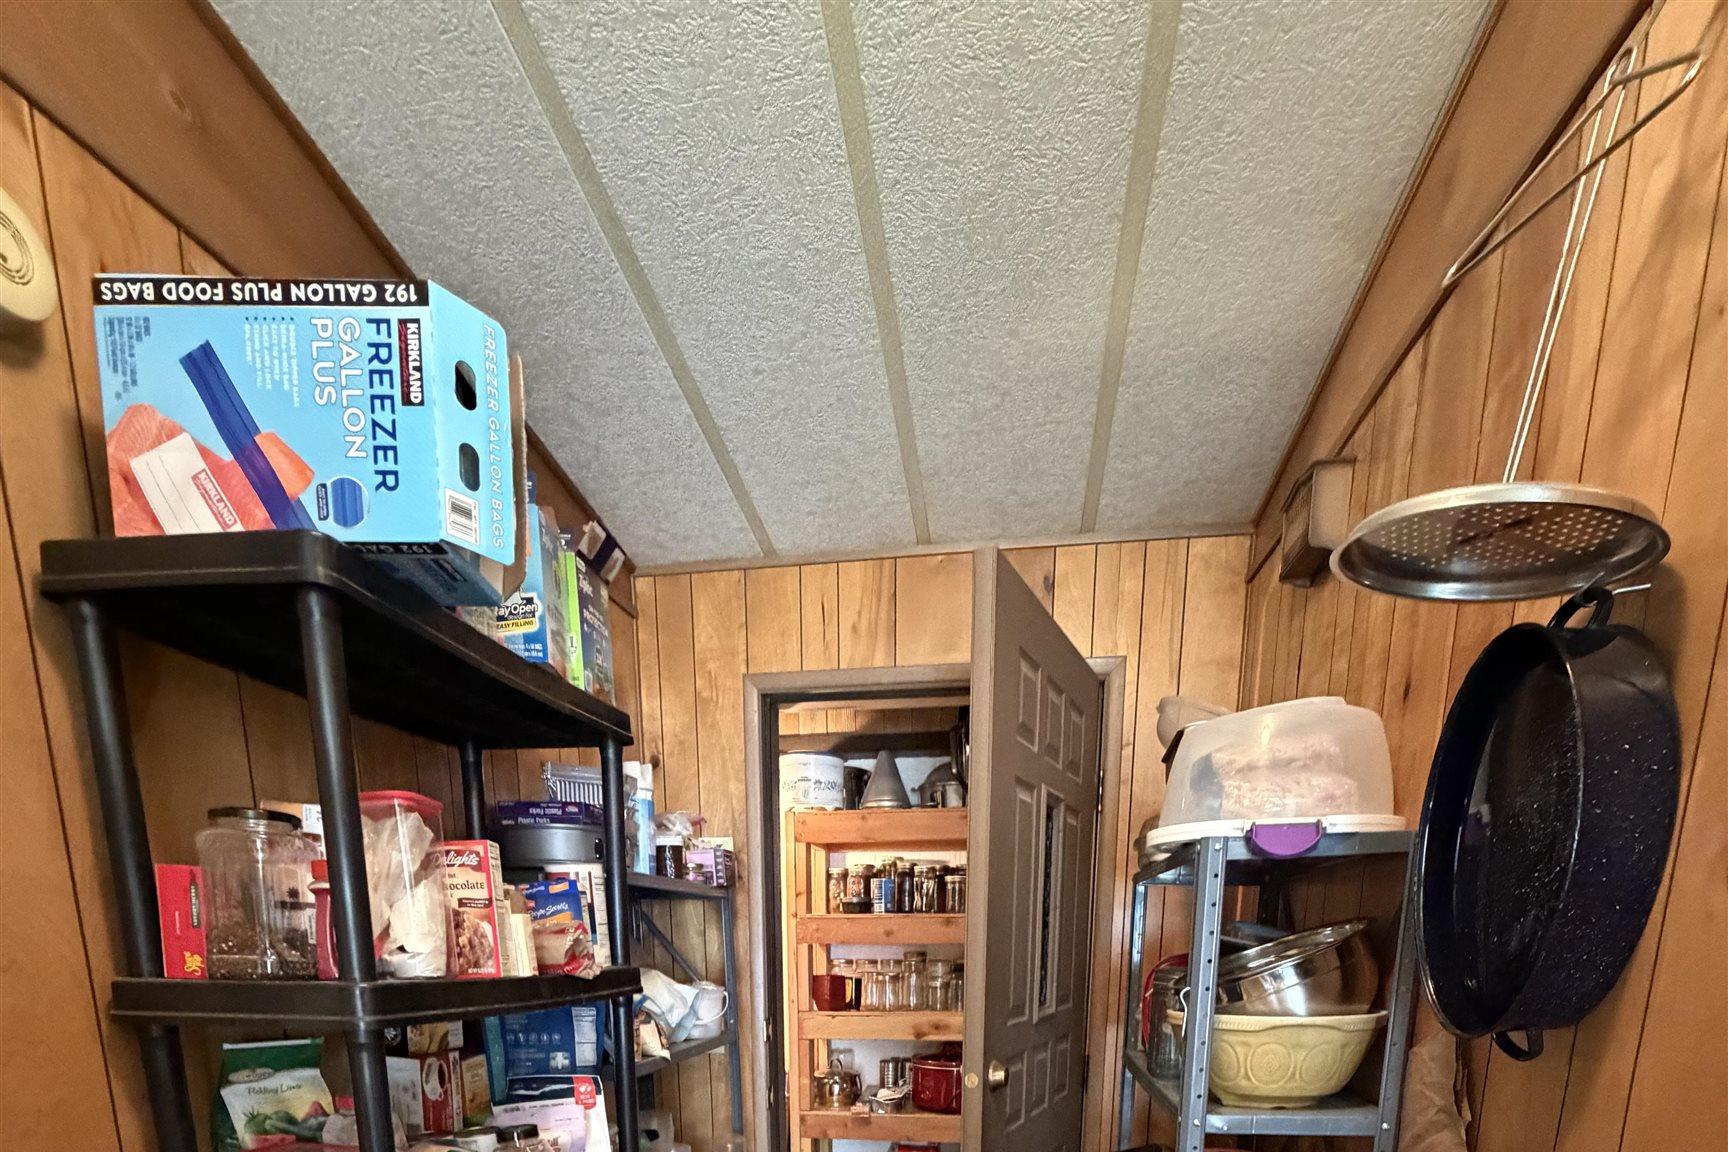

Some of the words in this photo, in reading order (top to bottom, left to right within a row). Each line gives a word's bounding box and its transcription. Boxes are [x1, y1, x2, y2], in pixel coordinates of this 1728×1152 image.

[100, 282, 155, 301] BAGS
[162, 282, 223, 301] FOOD
[232, 282, 282, 302] PLUS
[290, 283, 377, 303] GALLON
[384, 283, 418, 303] 192
[310, 316, 338, 406] PLUS
[338, 317, 368, 459] GALLON
[402, 320, 423, 405] KIRKLAND
[483, 324, 499, 412] FREEZER
[365, 317, 400, 493] FREEZER
[488, 418, 503, 493] GALLON
[195, 469, 236, 529] KIRKLAND
[491, 496, 505, 549] BAGS
